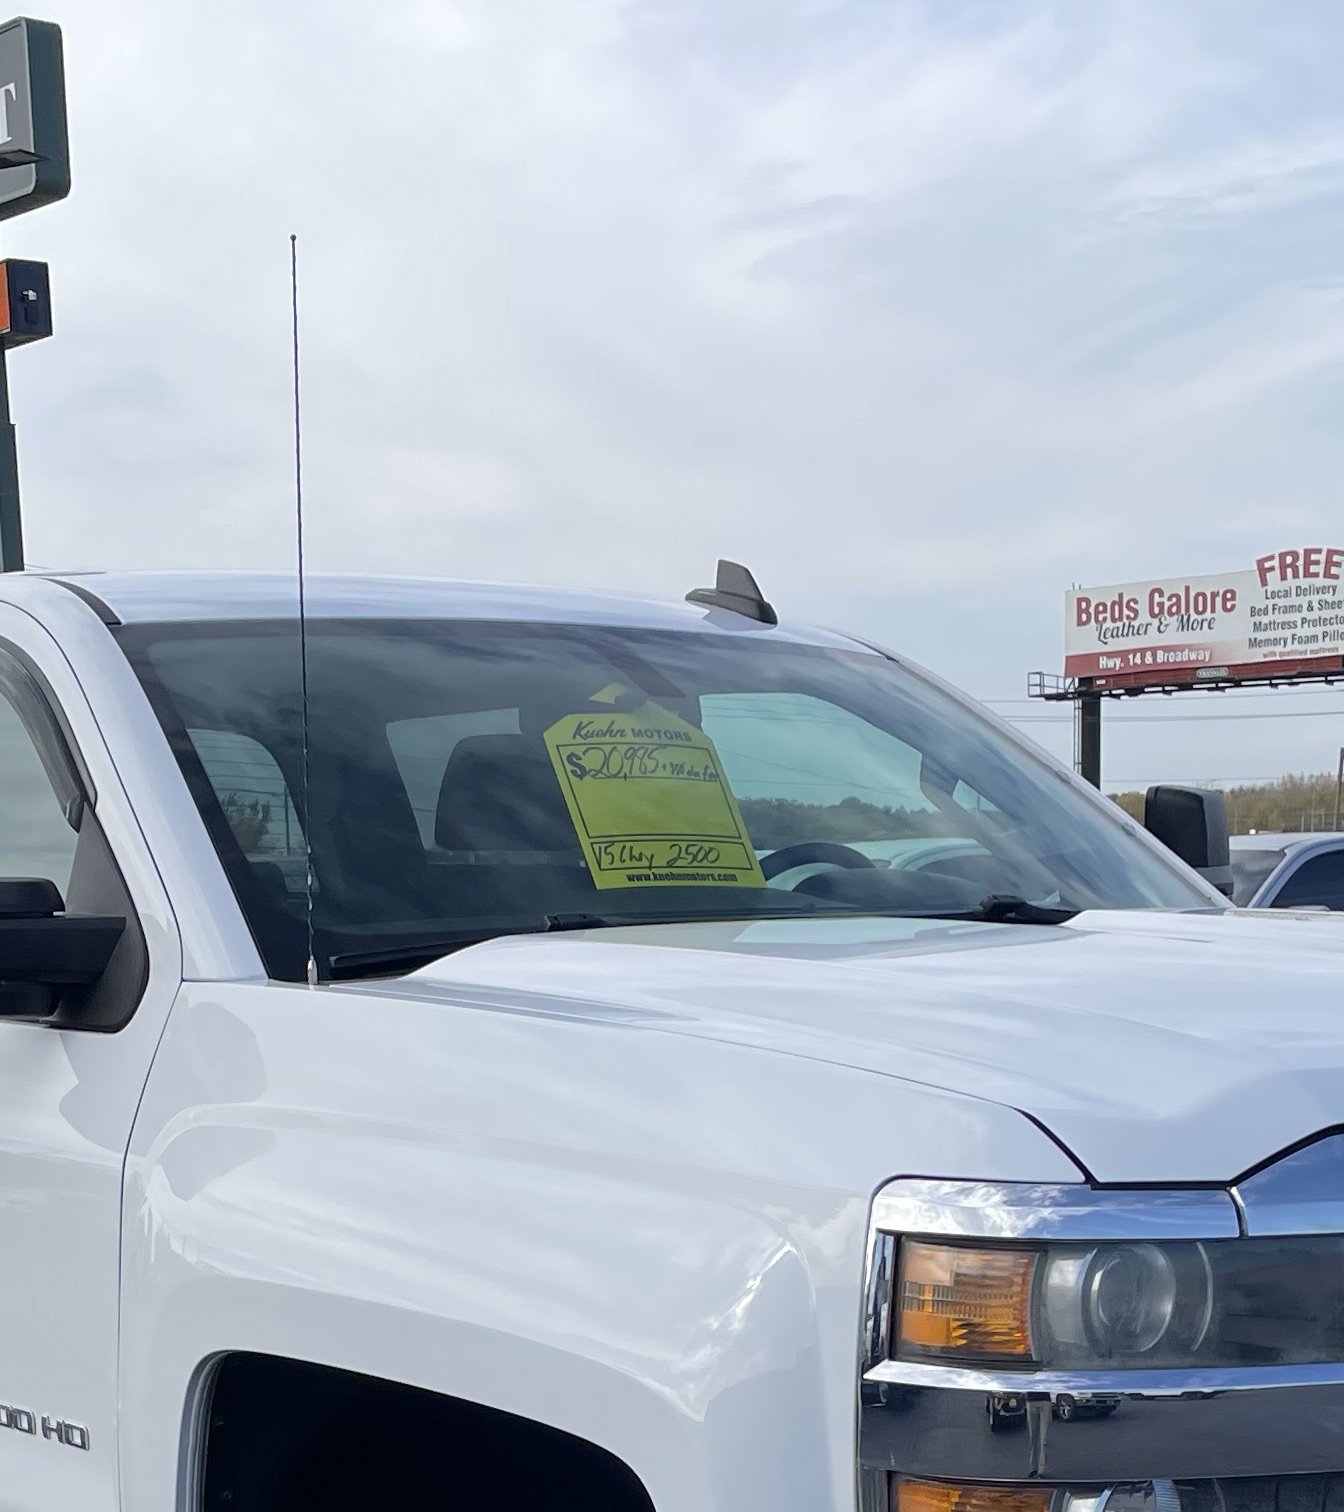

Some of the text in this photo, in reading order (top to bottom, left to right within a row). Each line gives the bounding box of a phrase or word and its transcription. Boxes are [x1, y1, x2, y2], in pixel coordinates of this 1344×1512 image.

[1265, 584, 1338, 600] Local Delivery
[1076, 585, 1237, 627] Beds Galore
[1250, 605, 1269, 617] Bed
[1272, 603, 1304, 615] Frame
[1306, 600, 1314, 612] &
[1096, 613, 1216, 645] Leather & More
[1252, 619, 1298, 633] Mattress
[1248, 637, 1288, 650] Memory
[1291, 633, 1319, 646] Foam
[1099, 649, 1211, 671] Hwy. 14 & Broadway
[631, 727, 692, 742] MOTORS
[666, 843, 721, 868] 2500
[41, 1415, 91, 1451] HD
